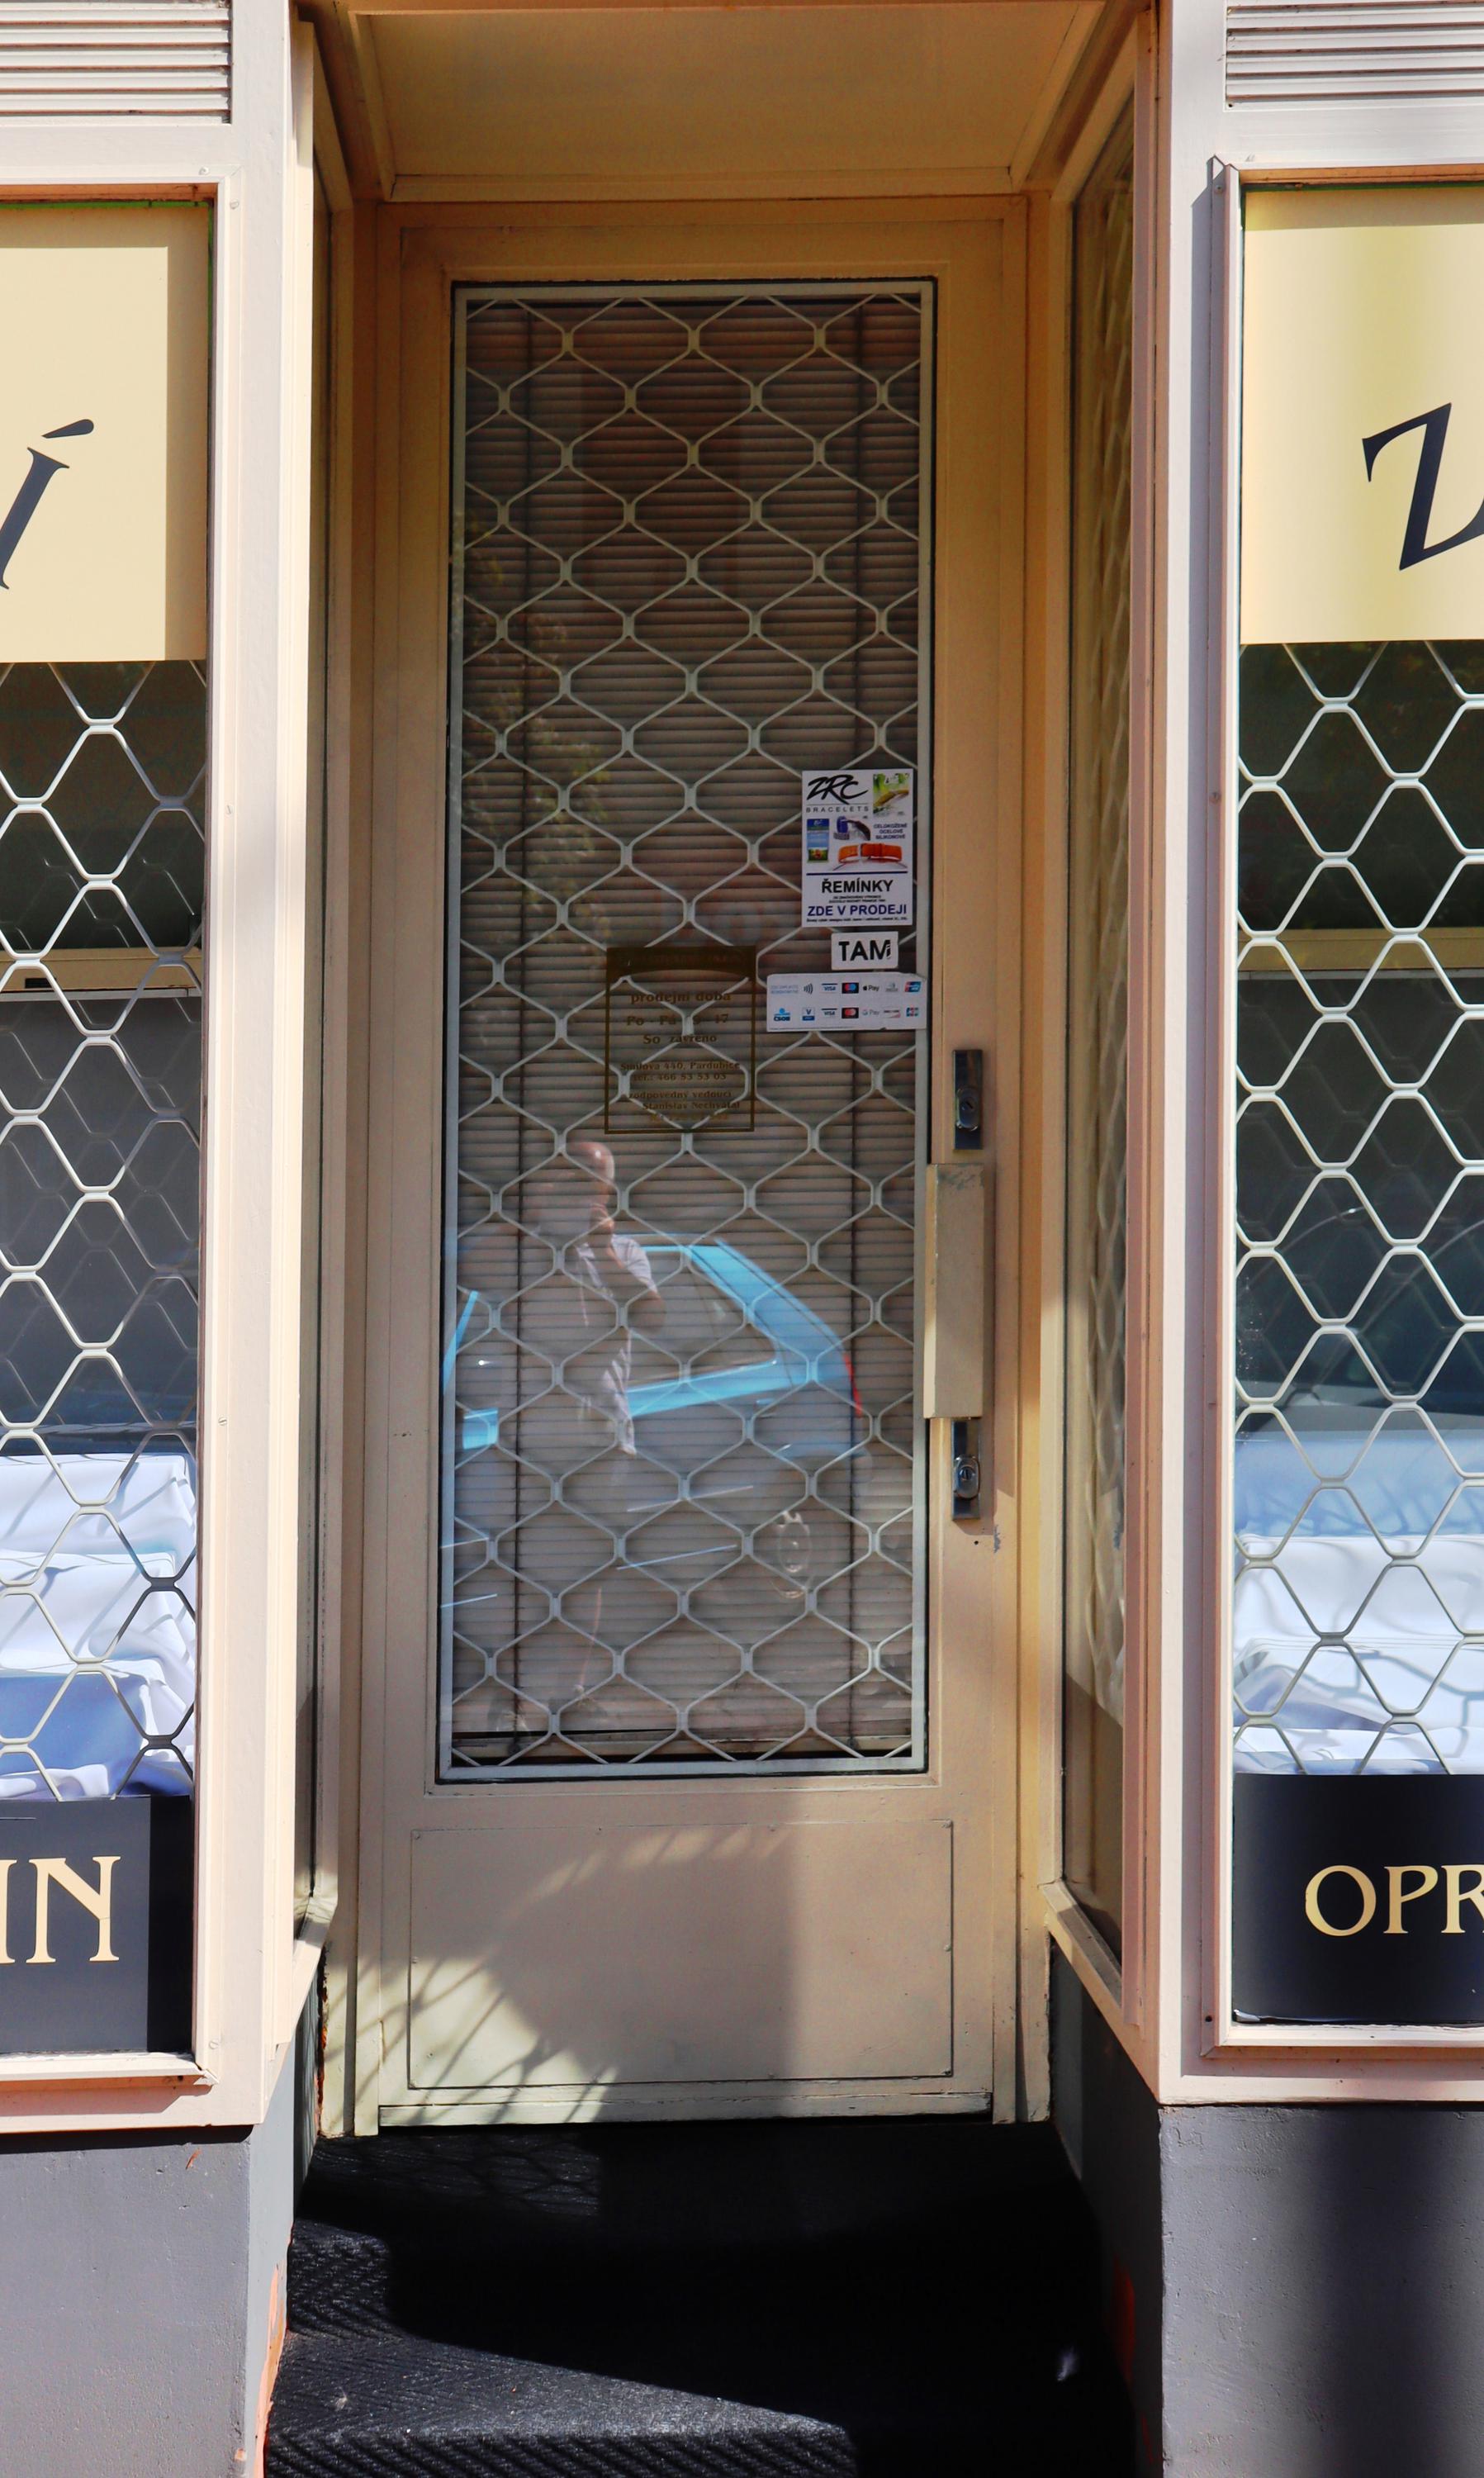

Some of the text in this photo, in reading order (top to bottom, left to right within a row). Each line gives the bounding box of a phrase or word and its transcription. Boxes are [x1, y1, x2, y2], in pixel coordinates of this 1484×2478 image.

[806, 774, 869, 805] ZRC
[821, 877, 894, 894] ŘEMÍNKY
[807, 904, 907, 917] ZDE V PRODEJI
[838, 939, 891, 961] TAM
[695, 991, 732, 1002] doba
[627, 1016, 645, 1026] Po
[642, 1034, 661, 1044] So
[690, 1061, 741, 1070] Pardubice
[643, 1101, 689, 1110] Stanislav
